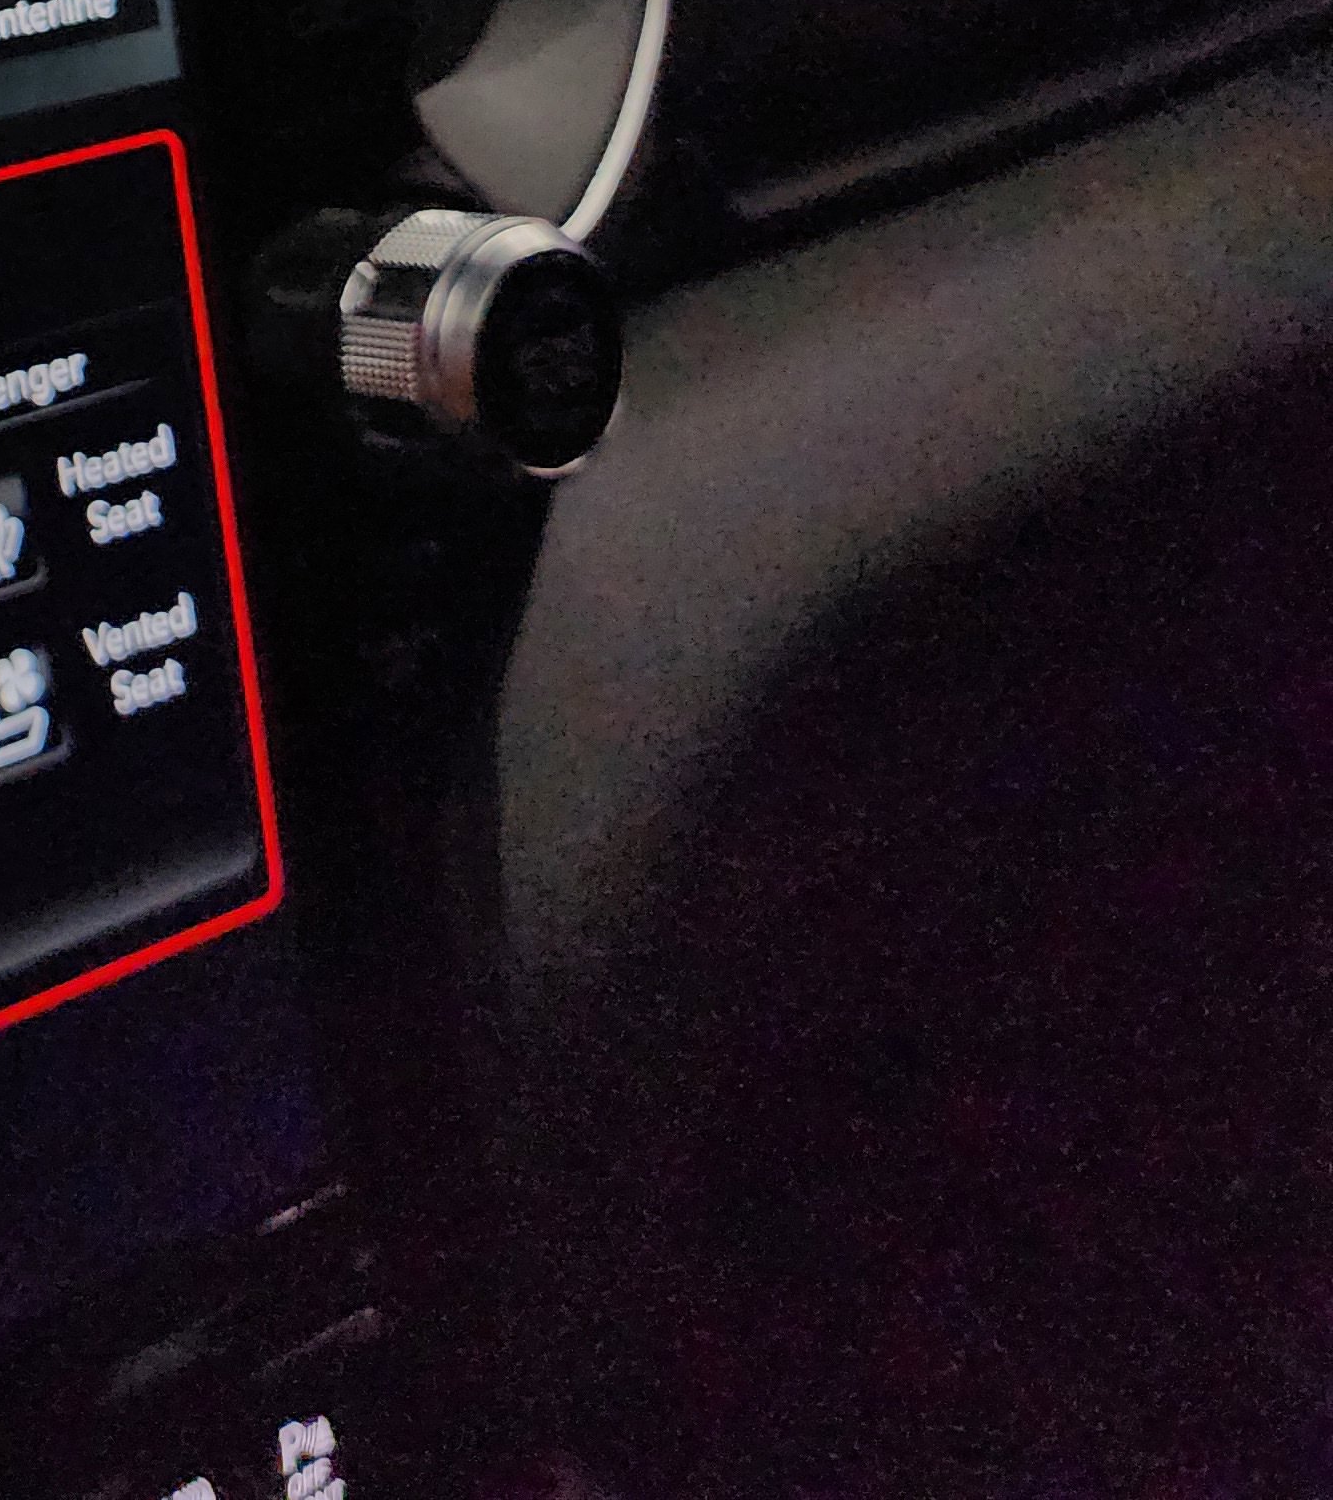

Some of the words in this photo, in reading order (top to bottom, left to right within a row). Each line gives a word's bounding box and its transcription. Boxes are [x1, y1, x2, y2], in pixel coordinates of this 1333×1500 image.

[57, 422, 175, 496] Heated
[87, 490, 163, 545] Seat
[82, 590, 196, 666] Vented
[110, 659, 187, 715] Seat
